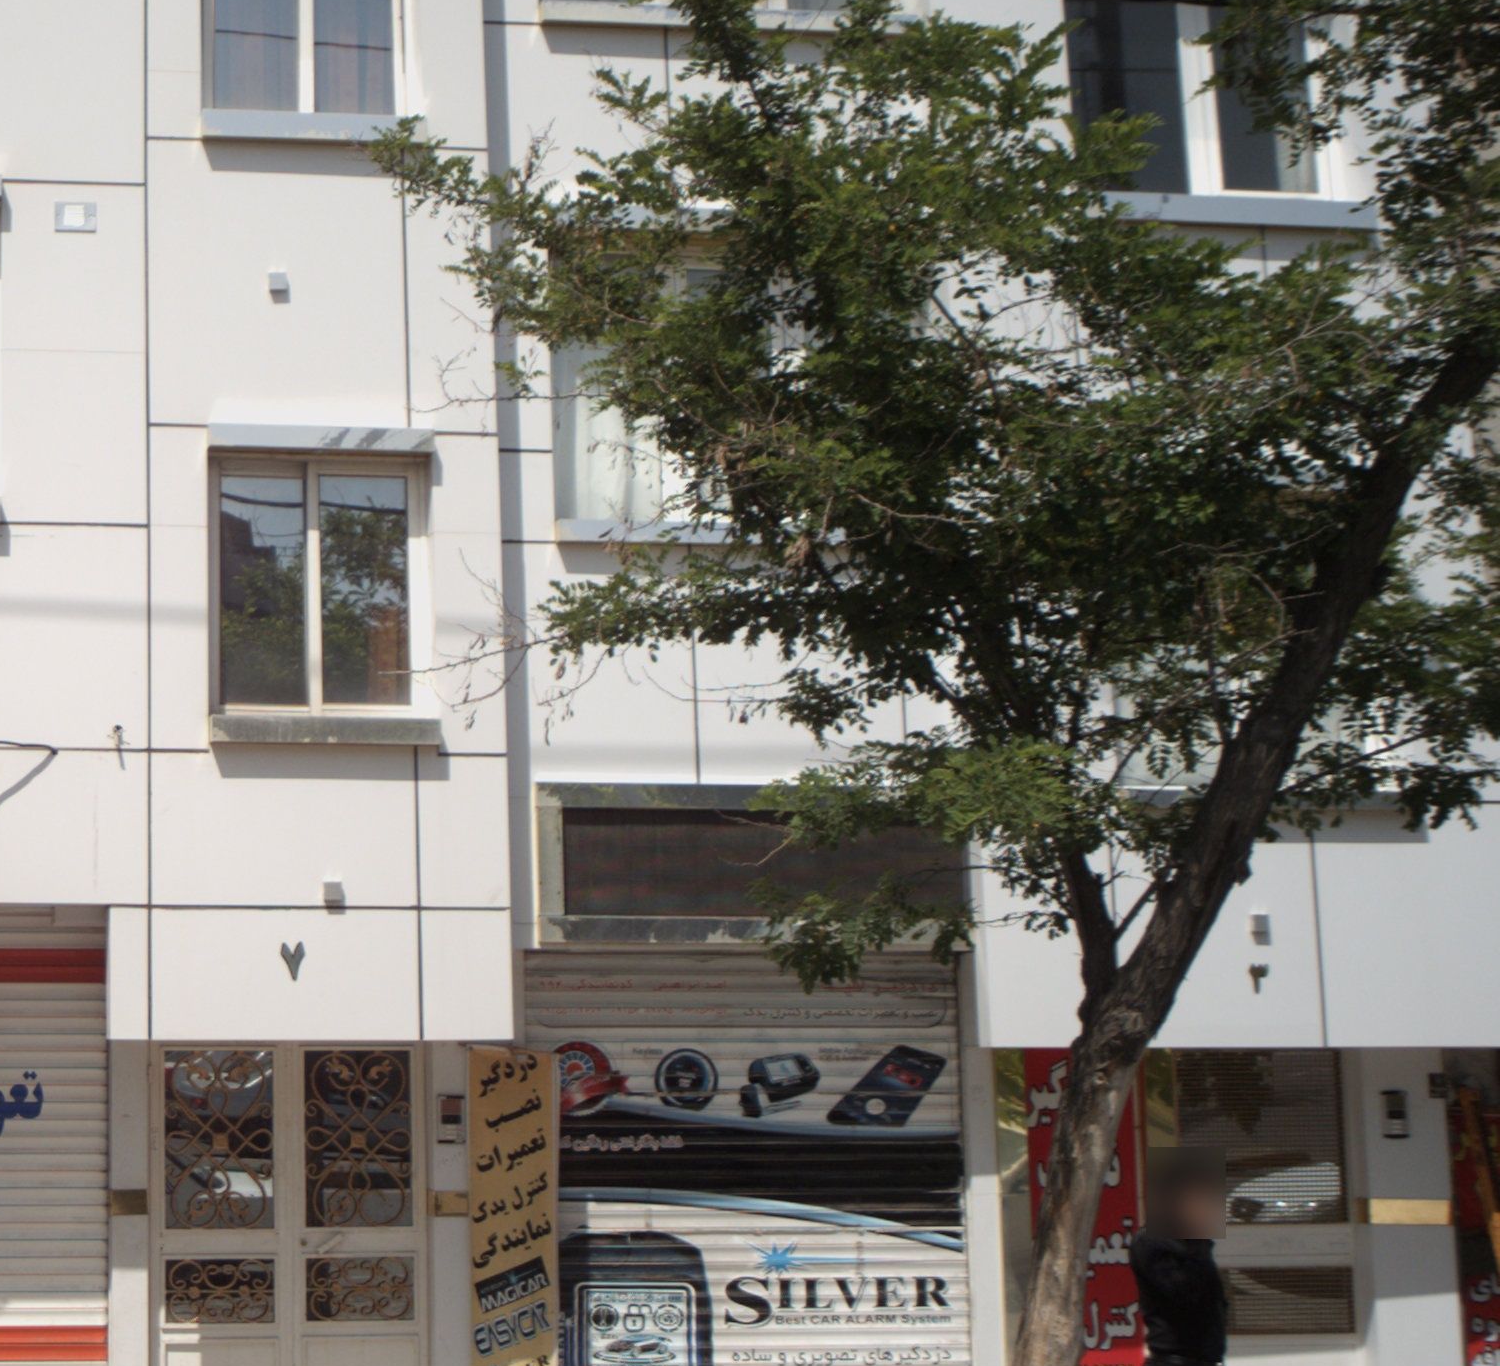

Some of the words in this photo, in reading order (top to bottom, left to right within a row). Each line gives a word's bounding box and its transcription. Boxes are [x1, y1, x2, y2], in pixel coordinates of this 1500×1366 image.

[280, 941, 305, 981] ۷
[485, 1088, 542, 1133] نصب
[476, 1127, 547, 1173] تعمیرات
[472, 1198, 510, 1224] یدک
[512, 1171, 549, 1211] کنترل
[472, 1213, 552, 1270] نمایندگی
[480, 1272, 549, 1314] MAGICAR
[724, 1275, 953, 1327] SILVER
[474, 1299, 552, 1359] EASYCAR
[775, 1314, 806, 1325] Best
[809, 1314, 841, 1325] CAR
[845, 1314, 897, 1325] ALARM
[901, 1313, 952, 1326] System
[731, 1348, 773, 1363] ساده
[777, 1351, 788, 1366] و
